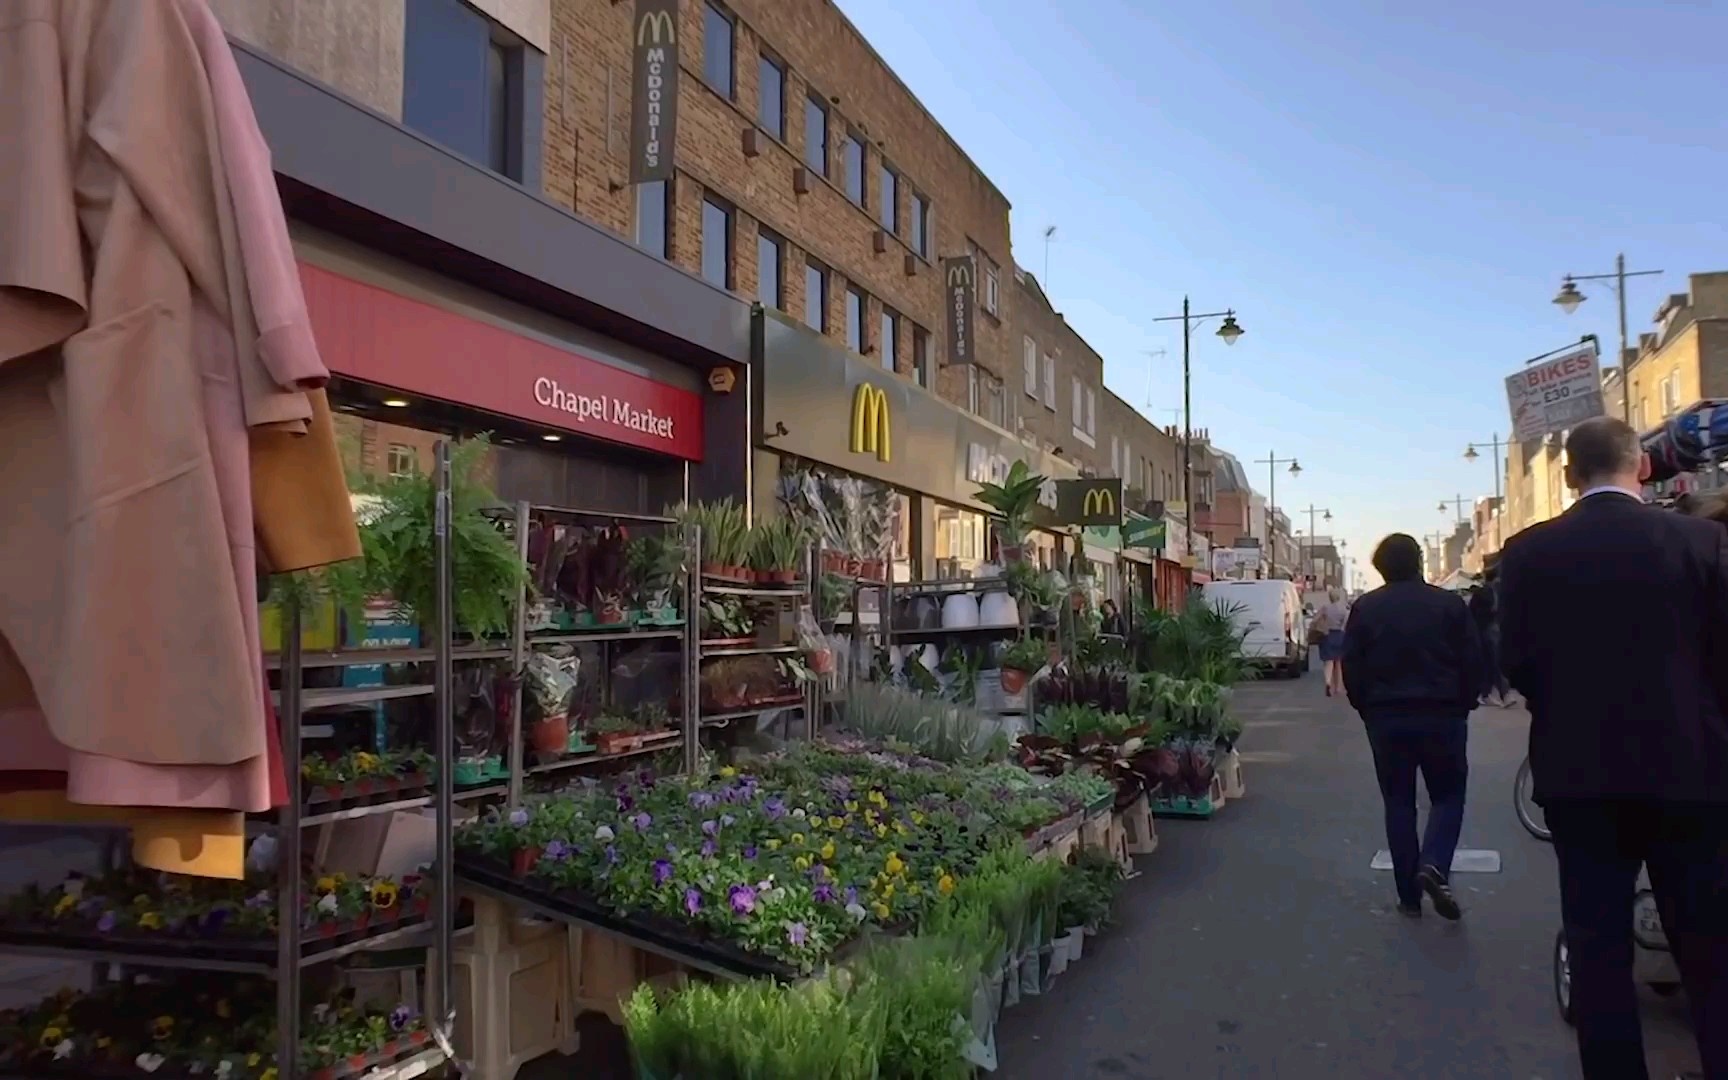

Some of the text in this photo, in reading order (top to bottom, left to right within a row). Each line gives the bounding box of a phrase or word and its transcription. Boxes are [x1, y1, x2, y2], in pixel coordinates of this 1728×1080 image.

[645, 48, 664, 167] McDonald's
[1527, 354, 1591, 388] BIKES
[1544, 386, 1570, 403] £30
[533, 376, 674, 439] Chapel Market
